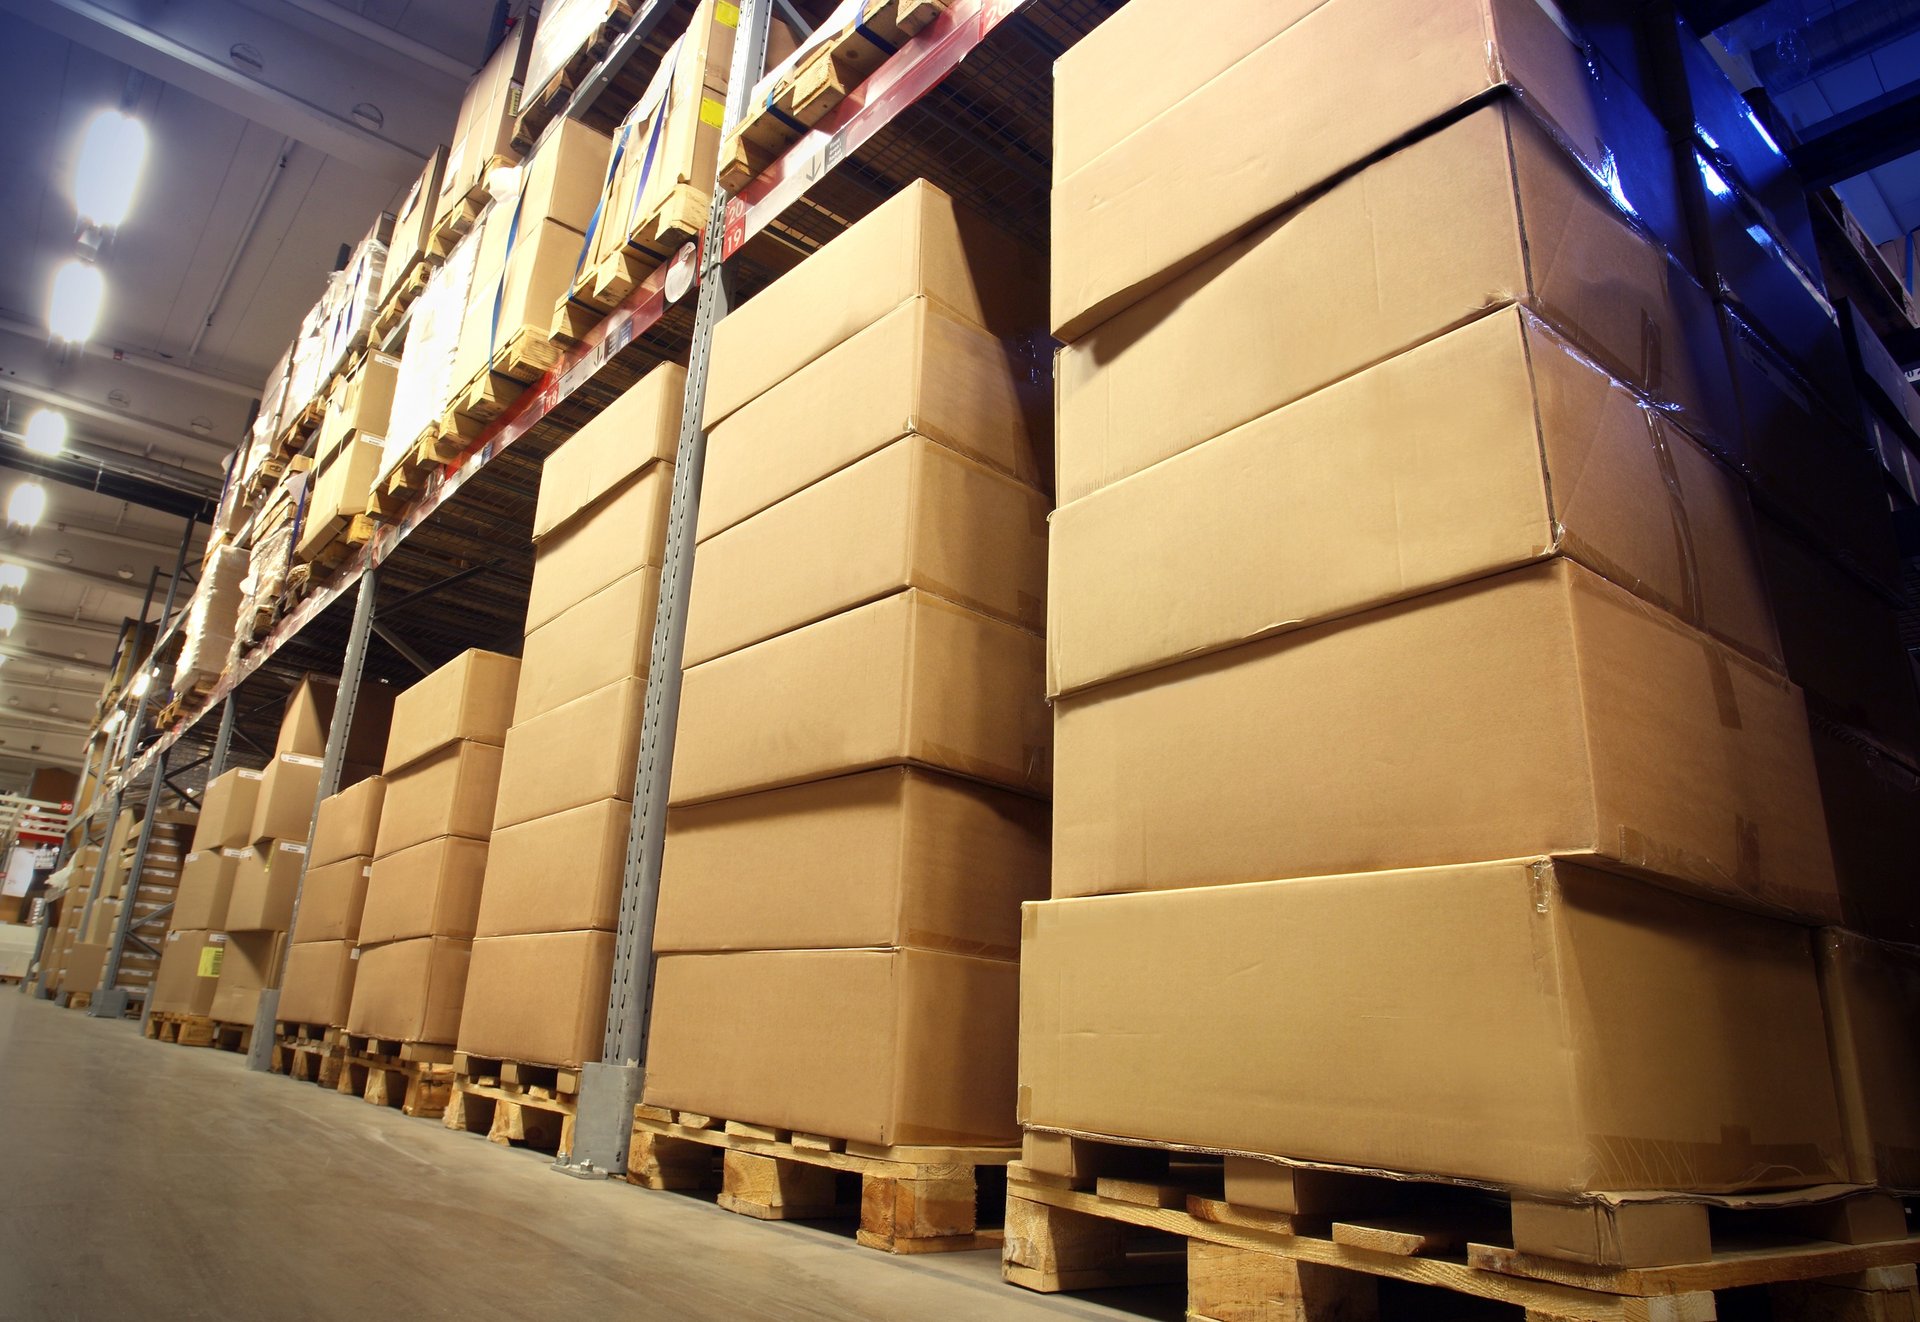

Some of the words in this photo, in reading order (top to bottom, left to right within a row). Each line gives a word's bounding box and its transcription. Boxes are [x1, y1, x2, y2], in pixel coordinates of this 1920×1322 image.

[728, 200, 744, 225] 20
[728, 229, 742, 253] 19
[546, 390, 557, 408] 18
[62, 803, 73, 811] 20
